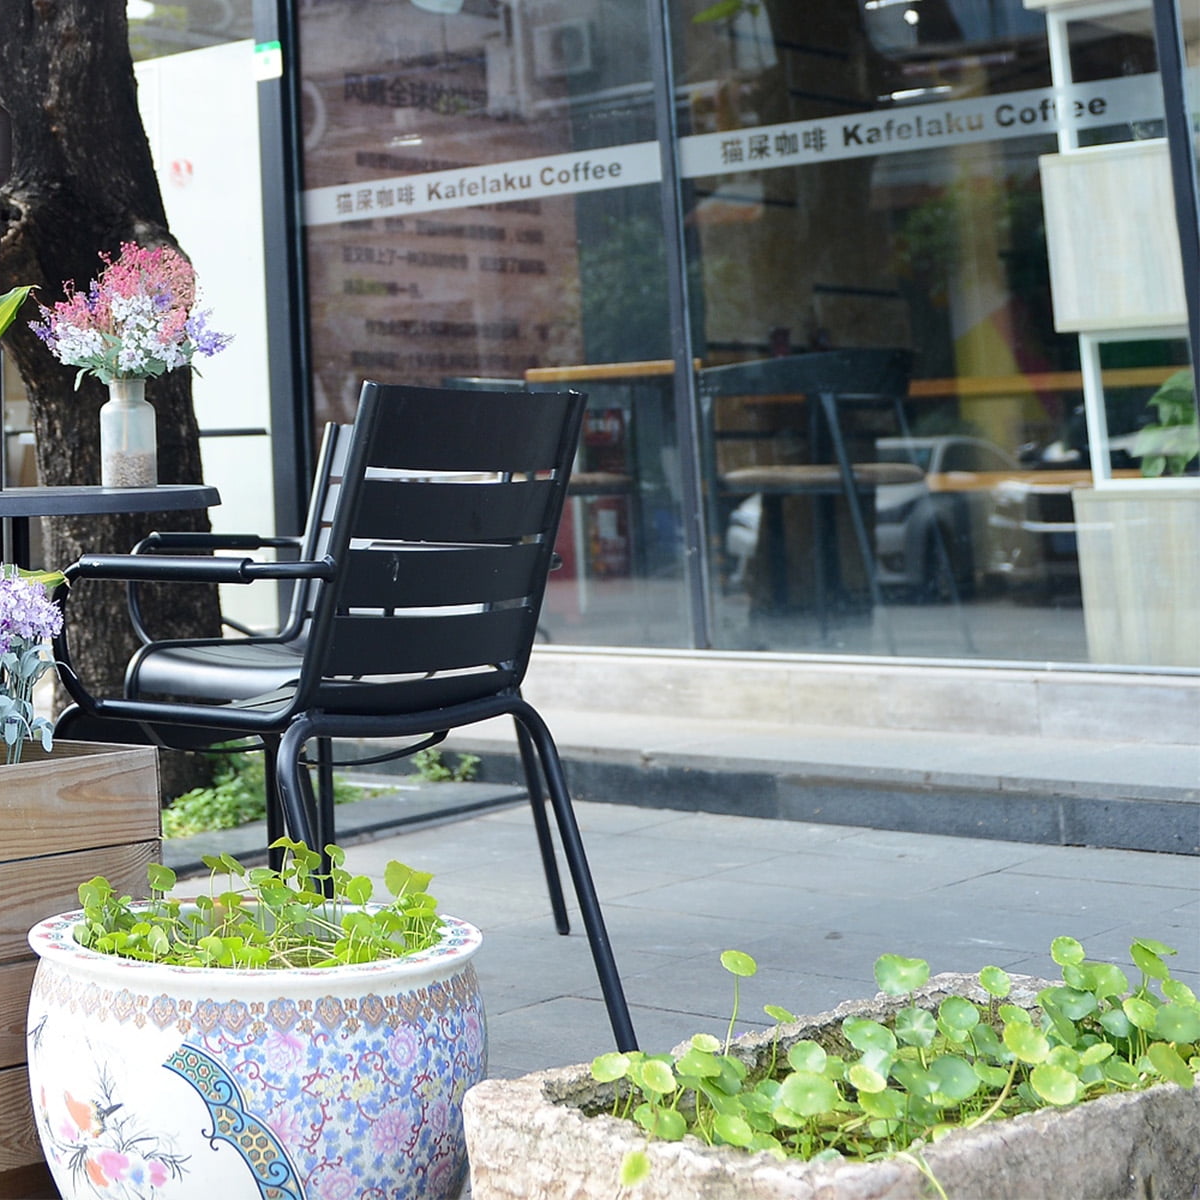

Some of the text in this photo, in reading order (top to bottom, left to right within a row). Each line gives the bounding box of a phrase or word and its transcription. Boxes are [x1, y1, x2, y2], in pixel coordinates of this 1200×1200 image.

[721, 97, 1107, 164] 猫屎咖啡 Kafelaku Cofee
[336, 160, 622, 215] 猫屎咖啡 Kafelaku Coffee
